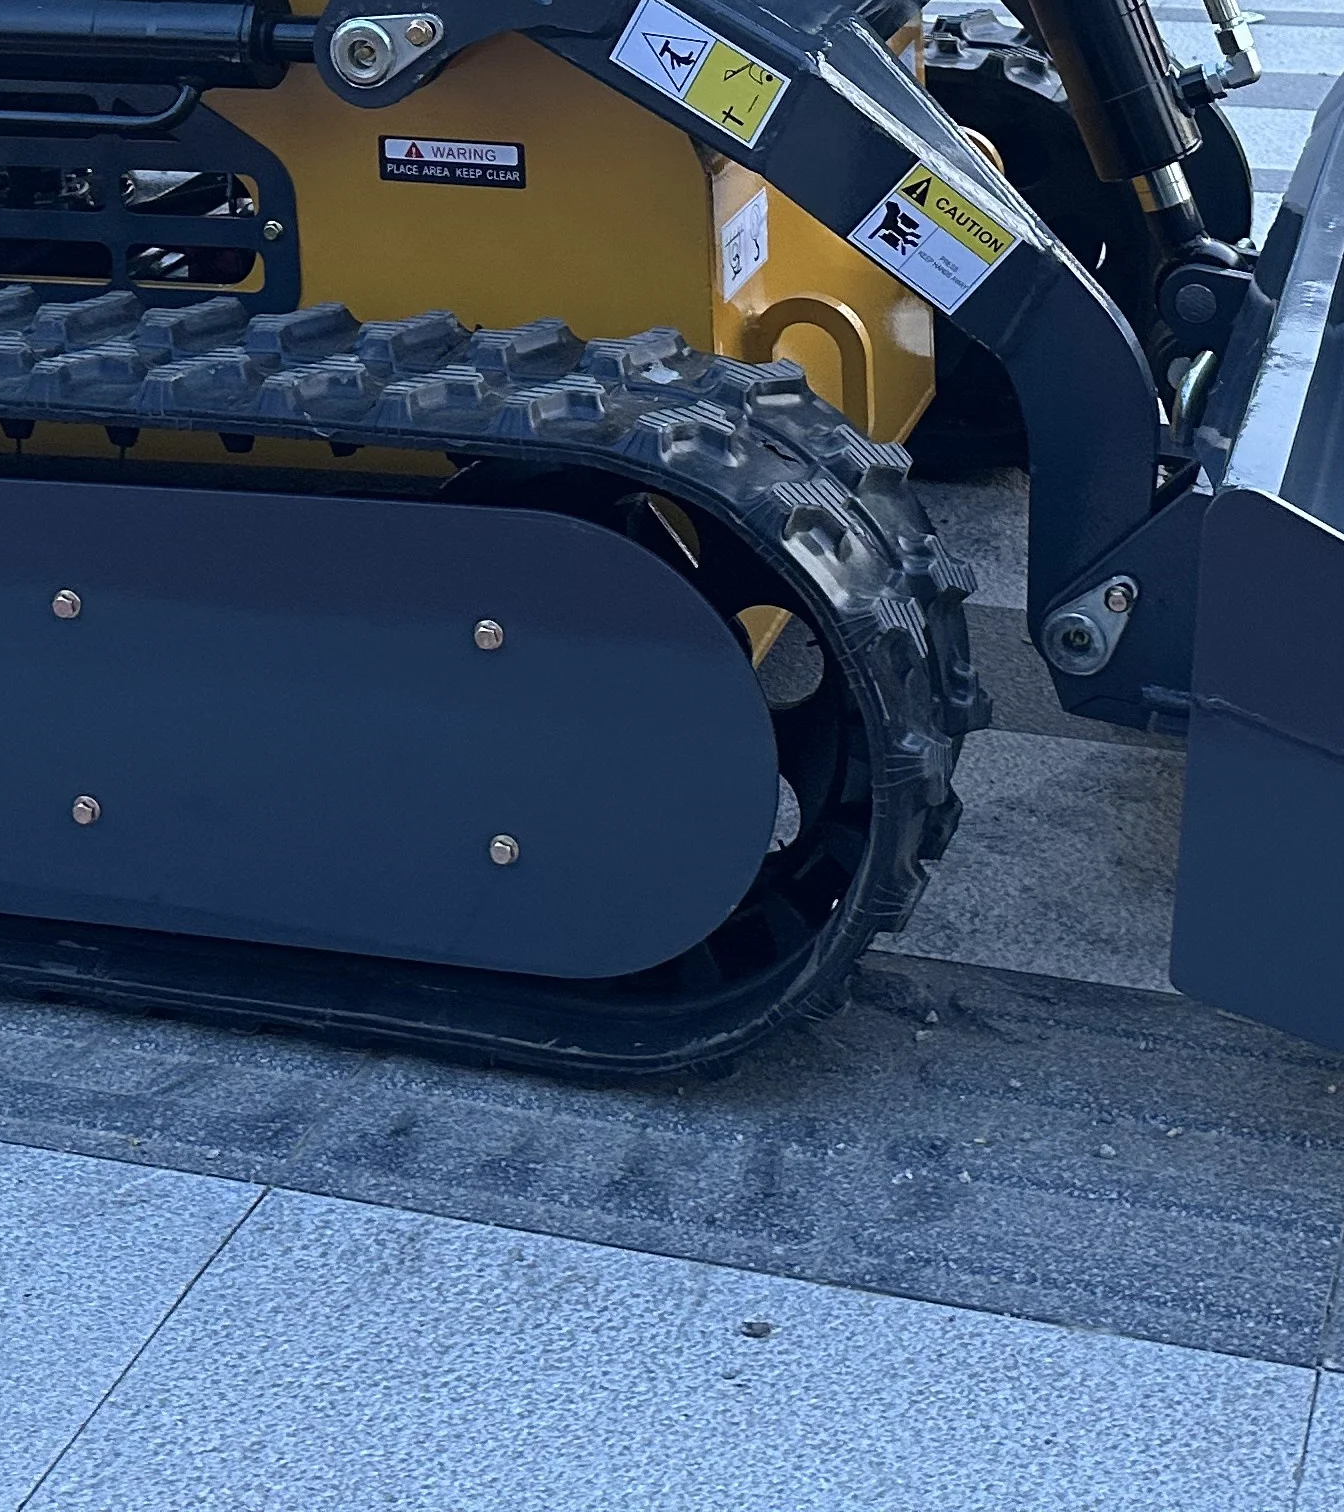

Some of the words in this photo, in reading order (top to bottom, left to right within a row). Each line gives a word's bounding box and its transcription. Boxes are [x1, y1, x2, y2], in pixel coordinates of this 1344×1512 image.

[431, 145, 496, 162] WARING
[387, 163, 419, 176] PLACE
[422, 166, 451, 178] AREA
[455, 167, 483, 179] KEEP
[486, 169, 520, 182] CLEAR
[936, 197, 1004, 253] CAUTION
